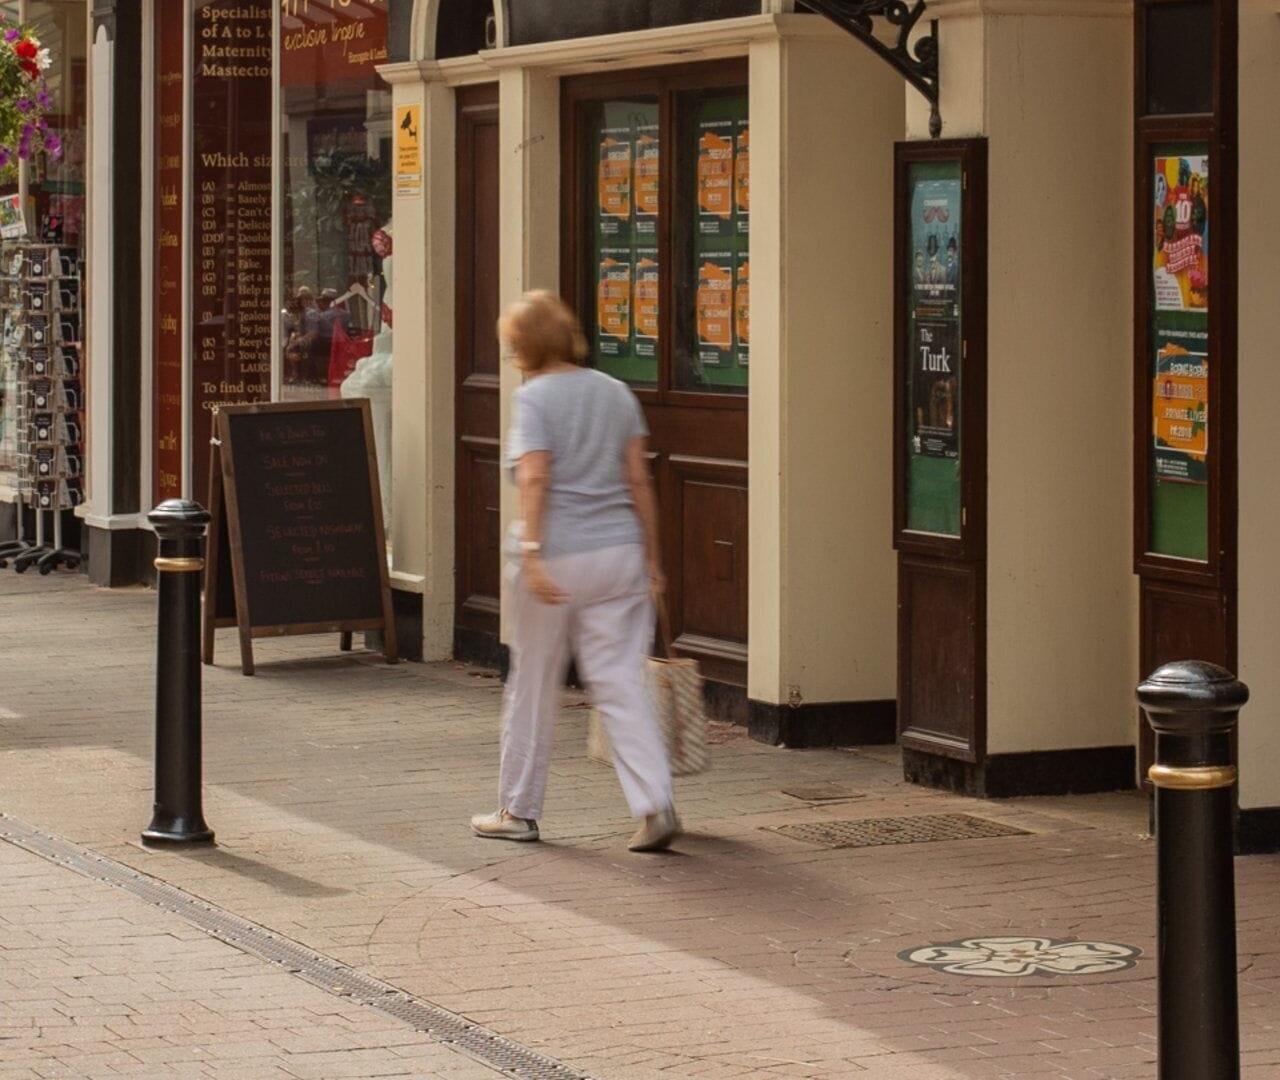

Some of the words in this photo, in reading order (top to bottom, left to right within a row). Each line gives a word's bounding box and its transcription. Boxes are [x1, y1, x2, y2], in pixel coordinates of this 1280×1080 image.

[202, 24, 219, 39] of
[222, 25, 233, 39] A
[236, 26, 252, 39] to
[255, 26, 265, 39] L
[284, 23, 328, 51] exclusive
[202, 45, 272, 61] Maternity
[202, 63, 272, 77] Mastecto
[202, 152, 249, 168] Which
[253, 153, 272, 168] siz
[202, 180, 216, 192] (A)
[238, 220, 272, 231] Delicio
[238, 285, 261, 297] Help
[240, 299, 259, 308] and
[238, 311, 271, 321] Jealou
[920, 328, 933, 343] The
[238, 337, 262, 349] Keep
[238, 351, 267, 361] You're
[920, 346, 951, 372] Turk
[202, 382, 217, 394] To
[220, 380, 245, 394] find
[247, 383, 268, 394] out
